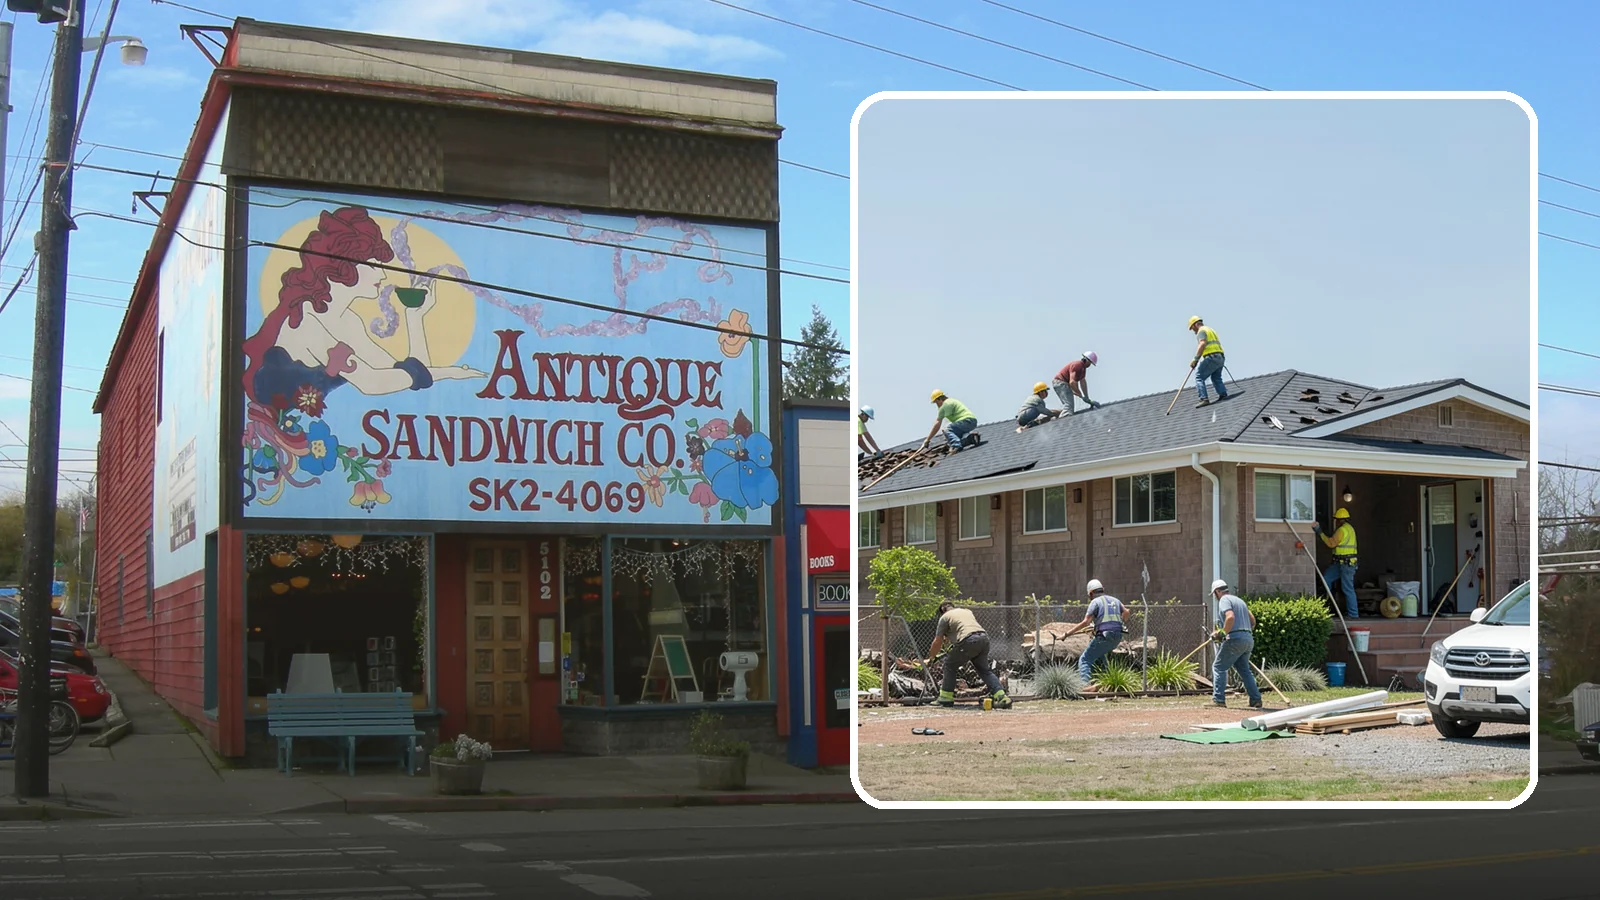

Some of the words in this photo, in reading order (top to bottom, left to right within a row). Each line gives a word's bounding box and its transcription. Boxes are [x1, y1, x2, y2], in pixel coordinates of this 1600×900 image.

[475, 328, 723, 421] ANTIQUE
[361, 408, 604, 467] SANDWICH
[617, 422, 685, 468] CO.
[469, 476, 645, 513] SK2-4069
[540, 541, 551, 599] 5102
[809, 555, 834, 569] BOOKS
